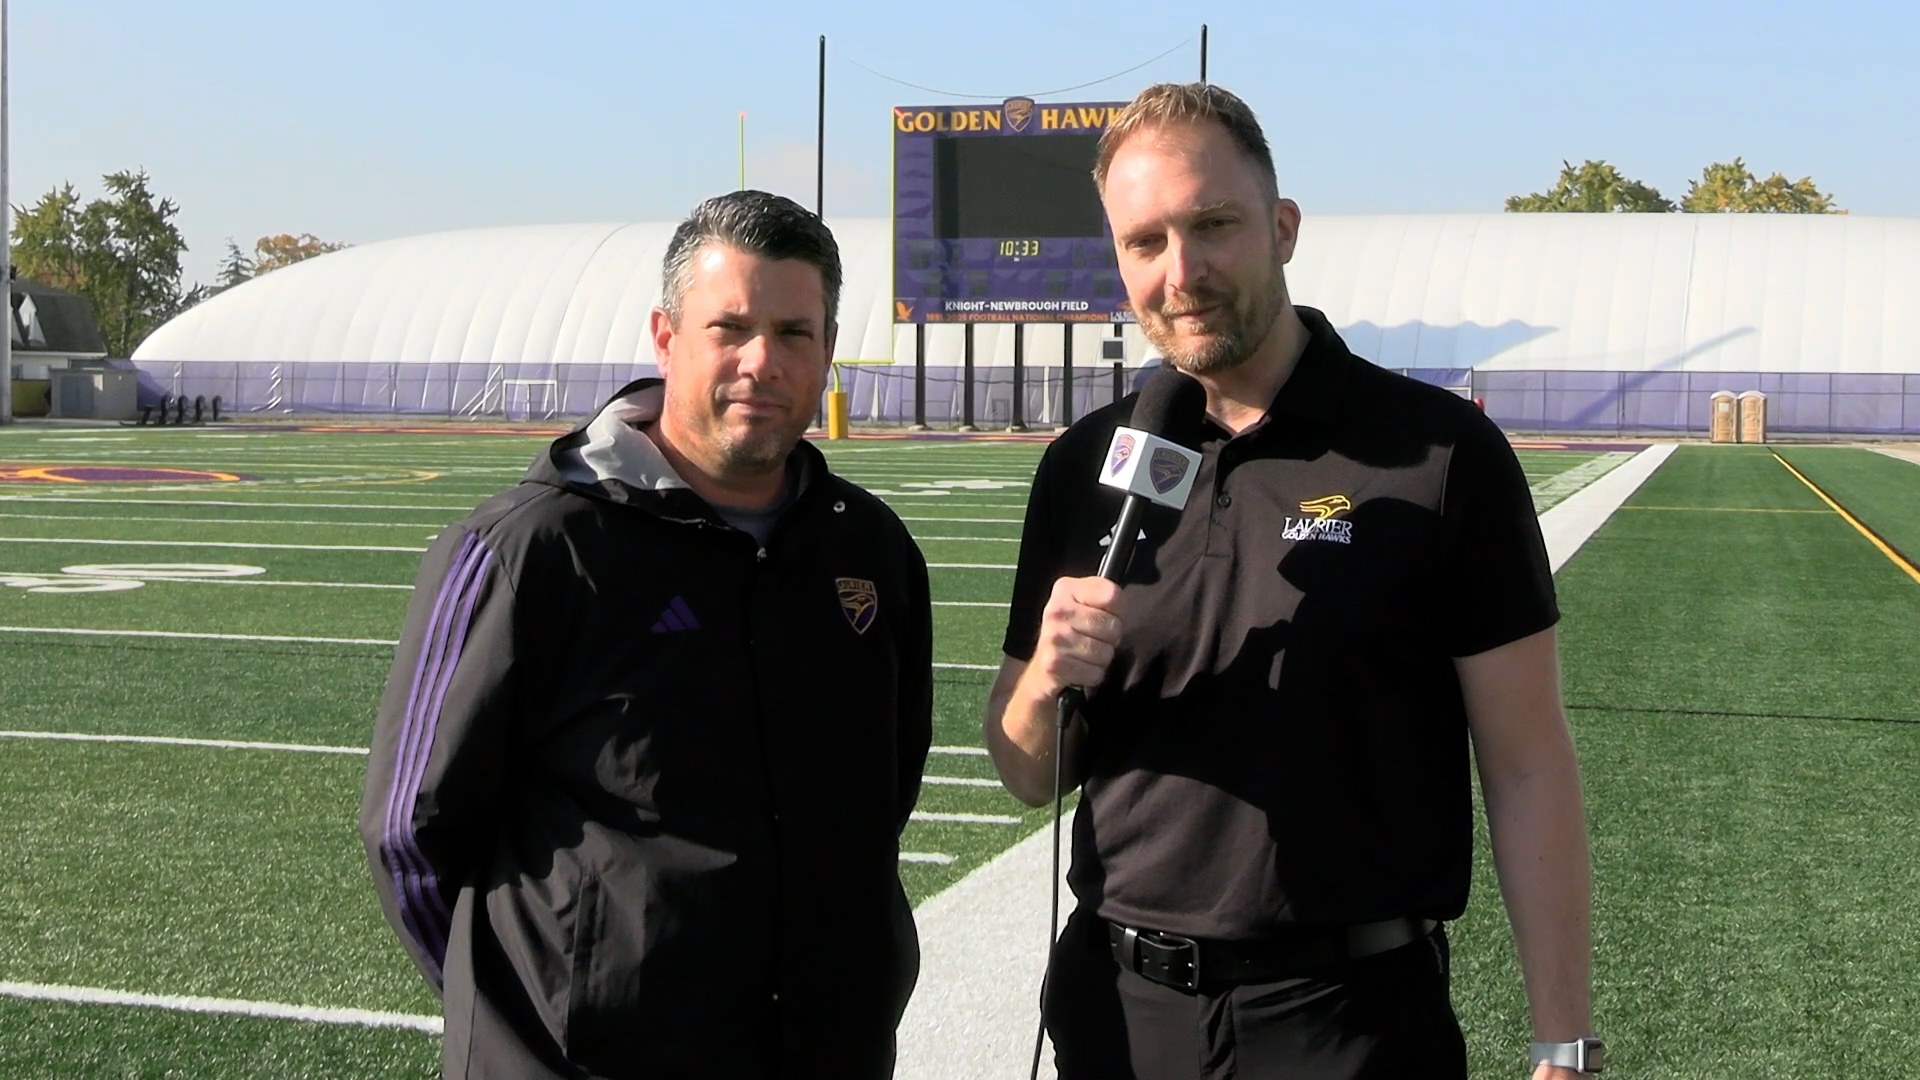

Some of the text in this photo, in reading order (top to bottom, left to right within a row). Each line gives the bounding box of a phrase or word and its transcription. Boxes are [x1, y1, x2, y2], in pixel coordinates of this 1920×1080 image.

[897, 106, 1127, 132] GOLDEN HAWK
[1000, 240, 1039, 256] 10:33
[945, 301, 1089, 311] KNIGHT-NEWBROUGH FIELD
[968, 313, 1010, 321] FOOTBALL
[1012, 313, 1054, 321] NATIONAL
[1056, 313, 1108, 321] CHAMPIONS
